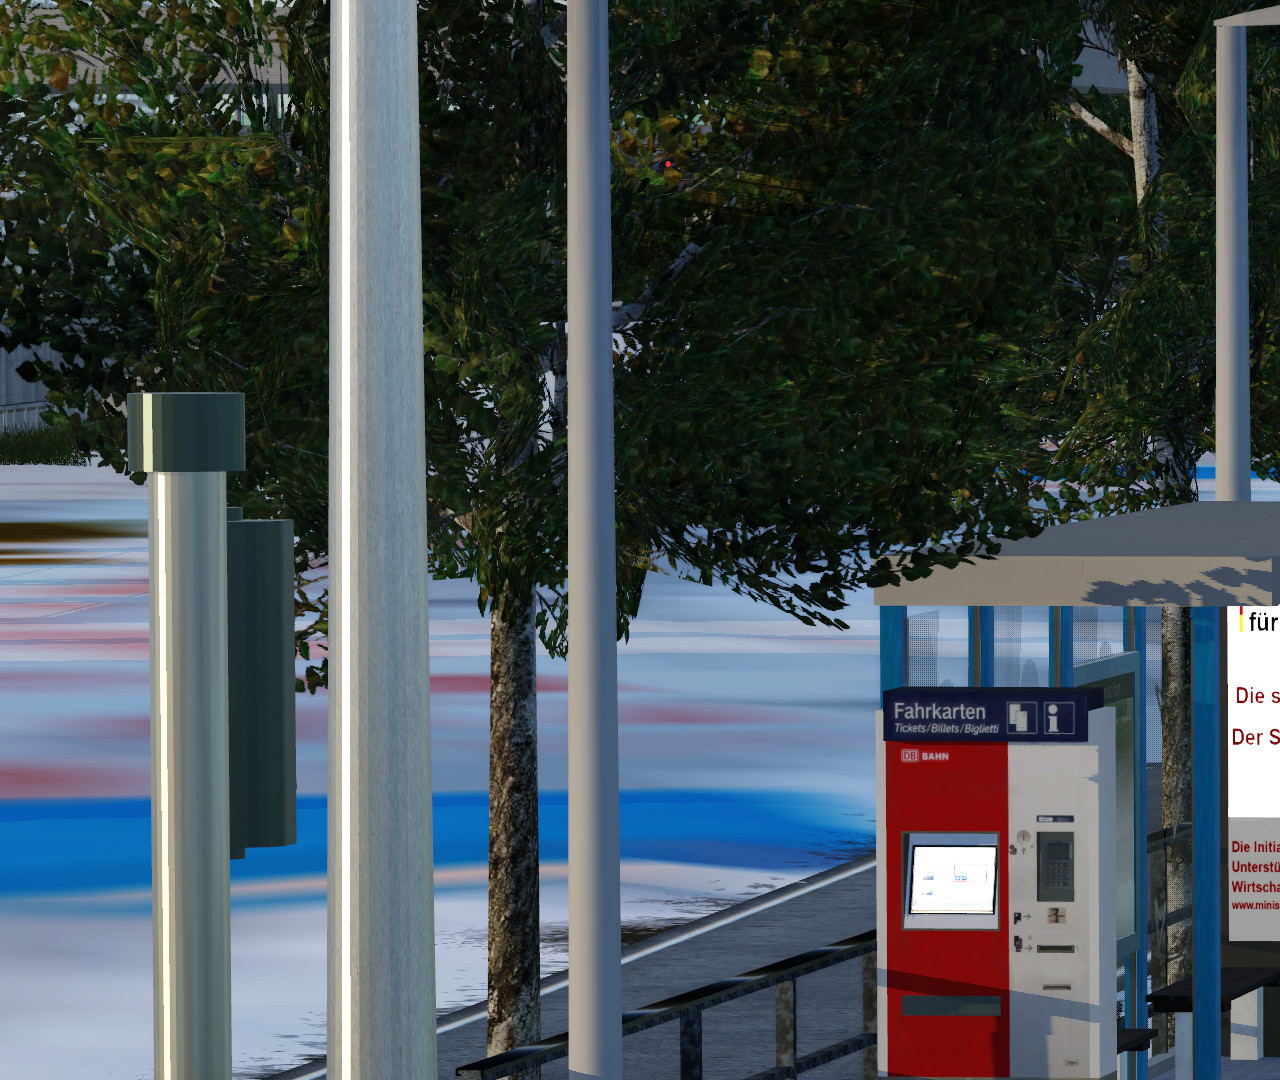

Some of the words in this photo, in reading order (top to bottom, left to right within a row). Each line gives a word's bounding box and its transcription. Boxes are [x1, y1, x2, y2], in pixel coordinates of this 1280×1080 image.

[1249, 612, 1278, 631] für
[1237, 687, 1264, 703] Die
[895, 702, 986, 720] Fahrkarten
[1233, 728, 1263, 745] Der
[902, 750, 919, 762] DB
[922, 752, 949, 761] BAHN
[1232, 841, 1250, 852] Die
